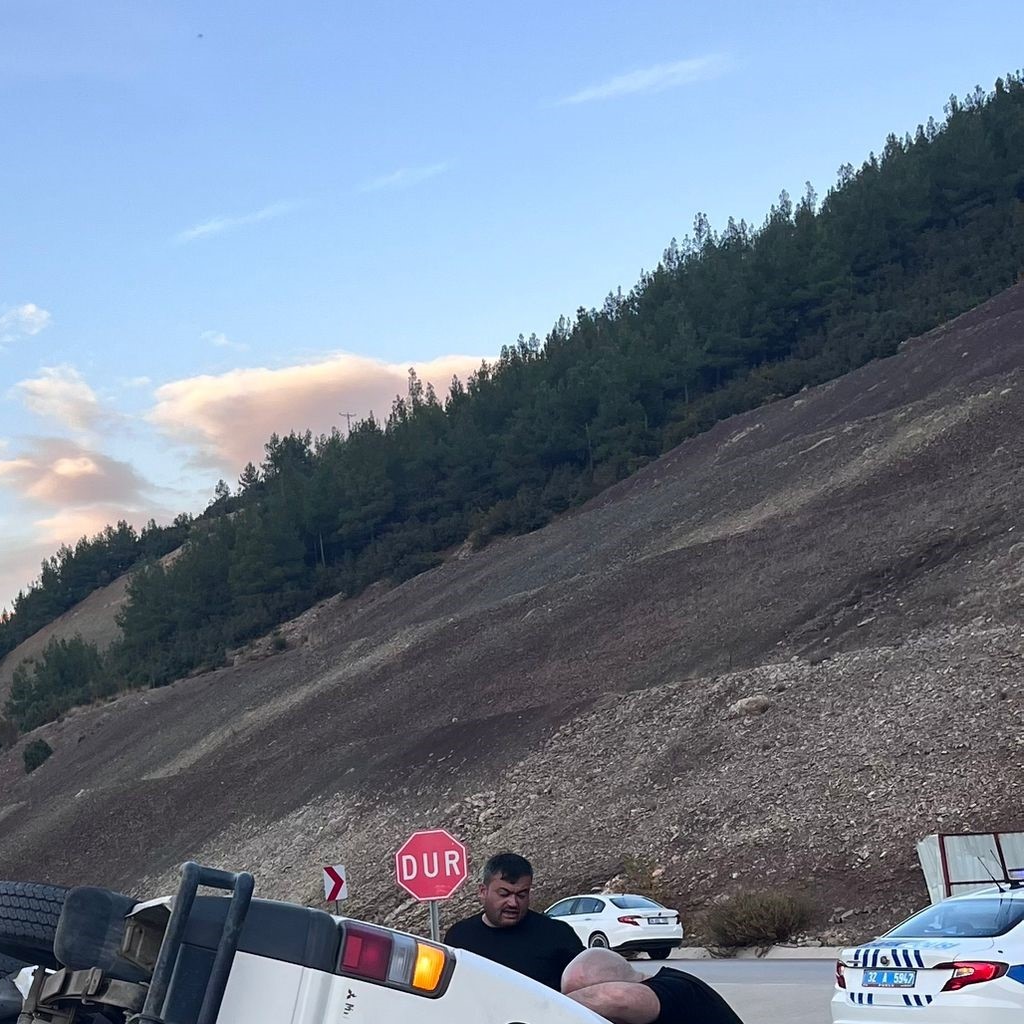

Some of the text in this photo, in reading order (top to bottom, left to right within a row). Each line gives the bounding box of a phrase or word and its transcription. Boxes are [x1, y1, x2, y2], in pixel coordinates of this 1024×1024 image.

[401, 850, 461, 881] DUR
[867, 972, 878, 983] 32
[881, 972, 888, 984] A
